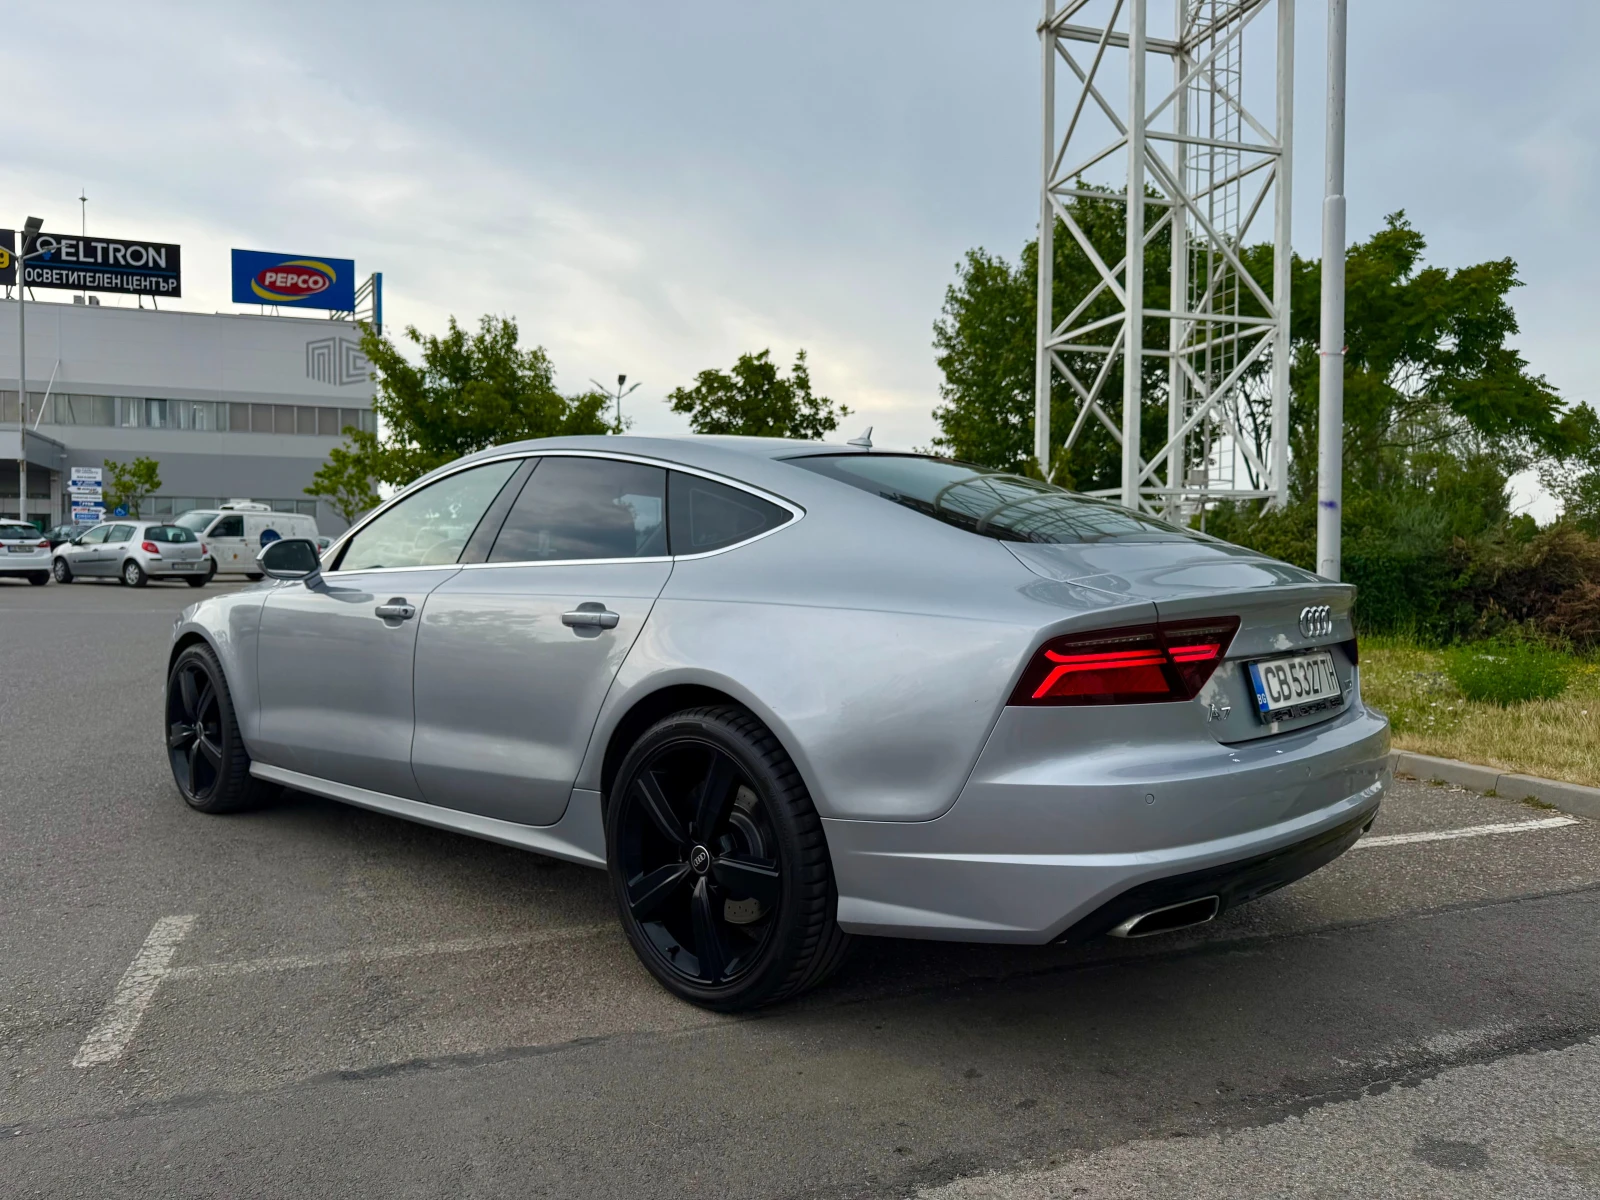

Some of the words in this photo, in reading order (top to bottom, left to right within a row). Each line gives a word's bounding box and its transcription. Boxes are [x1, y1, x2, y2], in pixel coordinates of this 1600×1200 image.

[25, 267, 121, 288] ОСВЕТИТЕЛЕН
[123, 274, 177, 292] ЦЕНТЪР
[264, 272, 324, 289] PEPCO
[1257, 693, 1267, 705] BG
